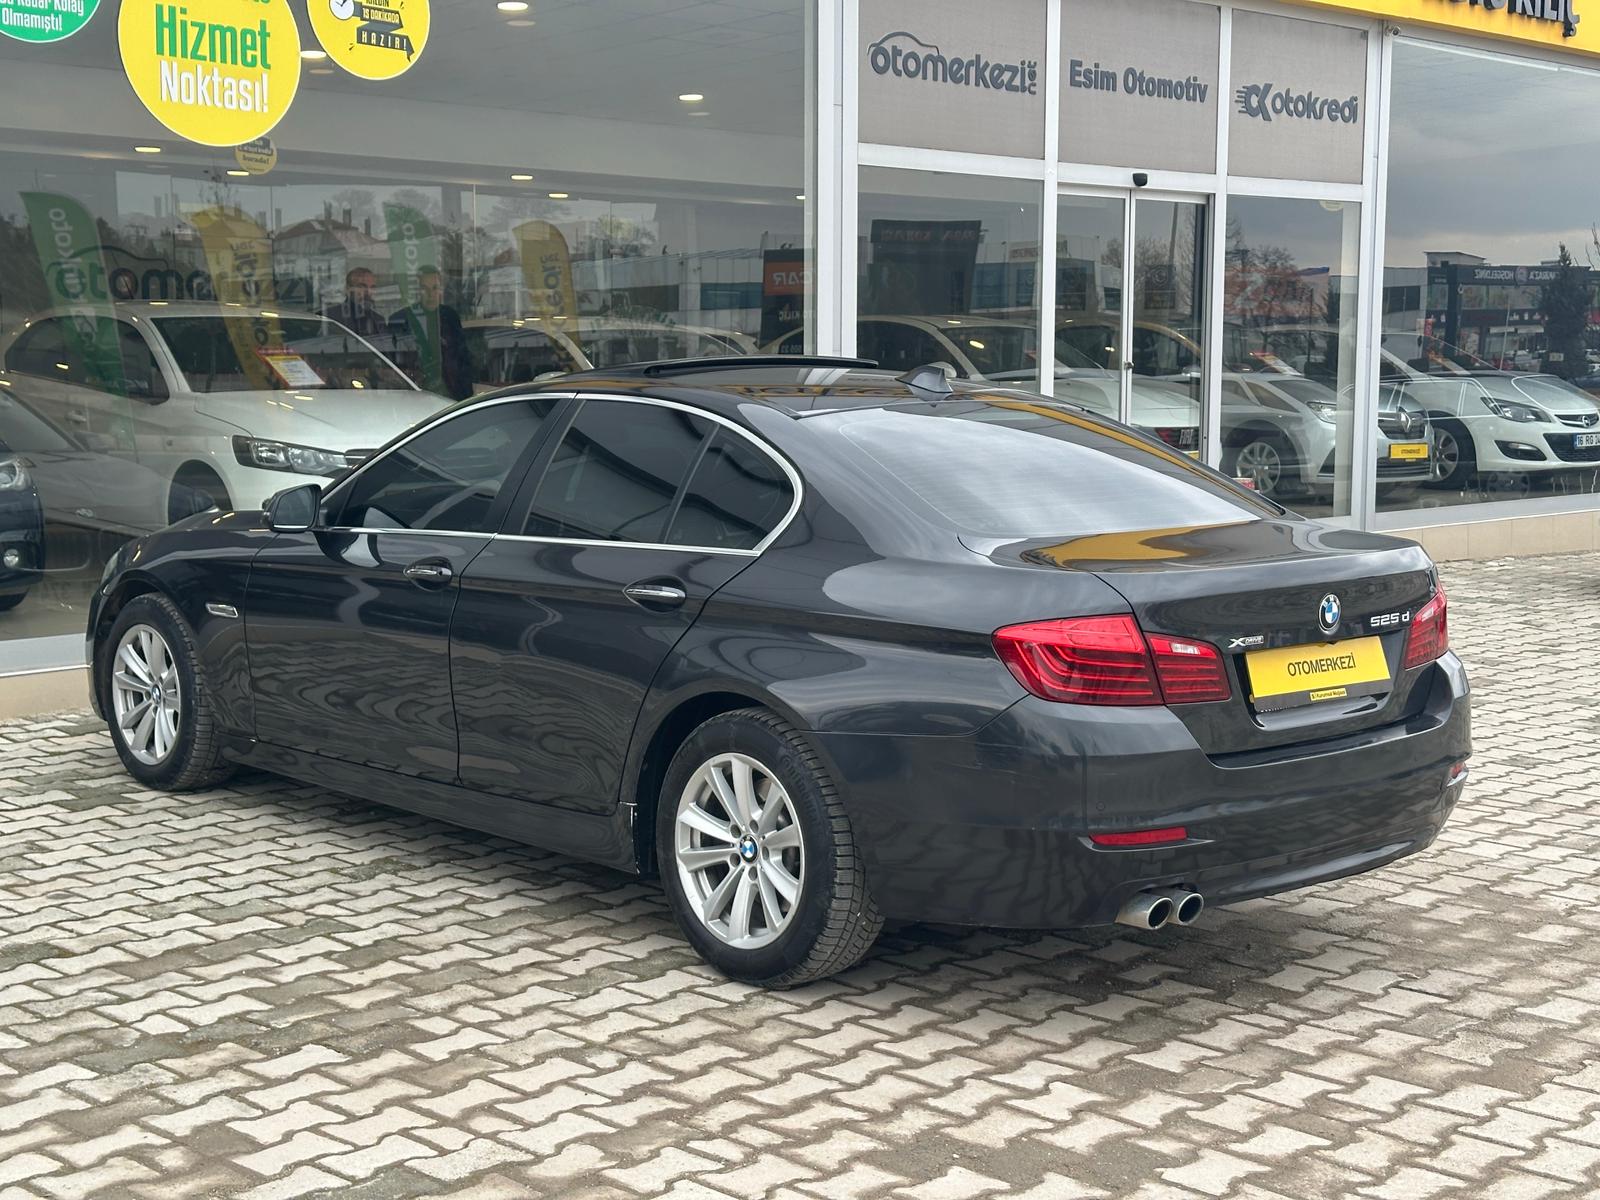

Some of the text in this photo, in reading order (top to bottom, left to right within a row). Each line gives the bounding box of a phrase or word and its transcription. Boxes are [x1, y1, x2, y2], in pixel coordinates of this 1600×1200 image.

[2, 7, 63, 33] Olmamıştı!
[155, 3, 272, 70] Hizmet
[361, 30, 407, 50] HAZIR!
[160, 60, 269, 113] Noktası!
[870, 45, 1028, 93] otomerkezi
[1069, 59, 1209, 103] Esim Otomotiv
[1271, 87, 1359, 124] otokredi
[1370, 610, 1411, 627] 525 d
[1287, 652, 1357, 677] OTOMERKEZİ
